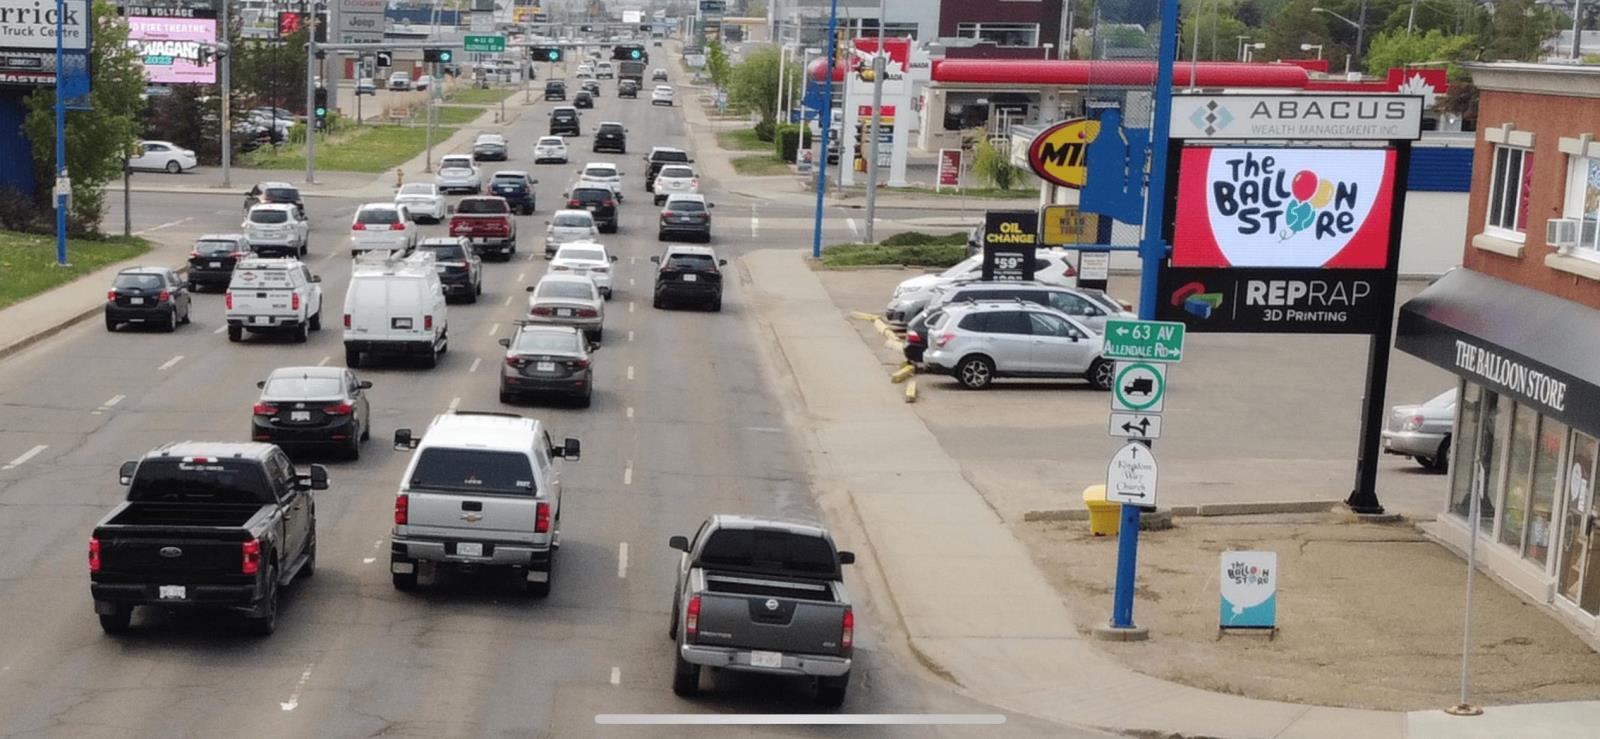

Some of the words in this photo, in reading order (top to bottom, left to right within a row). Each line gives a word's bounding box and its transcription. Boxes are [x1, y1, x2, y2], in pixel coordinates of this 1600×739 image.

[0, 1, 80, 25] rrick
[349, 16, 375, 28] Jeep
[2, 26, 34, 36] Truck
[1250, 100, 1406, 120] ABACUS
[1251, 124, 1296, 135] WEALTH
[1299, 125, 1377, 136] MANAGEMENT
[1225, 152, 1276, 182] The
[1000, 223, 1023, 234] OIL
[986, 233, 1035, 244] CHANGE
[1245, 280, 1371, 306] REPRAP
[1262, 309, 1282, 322] 3D
[1132, 325, 1150, 340] 63
[1157, 326, 1175, 341] AV
[1455, 339, 1478, 373] THE
[1476, 347, 1528, 395] BALLOON
[1526, 369, 1567, 411] STORE
